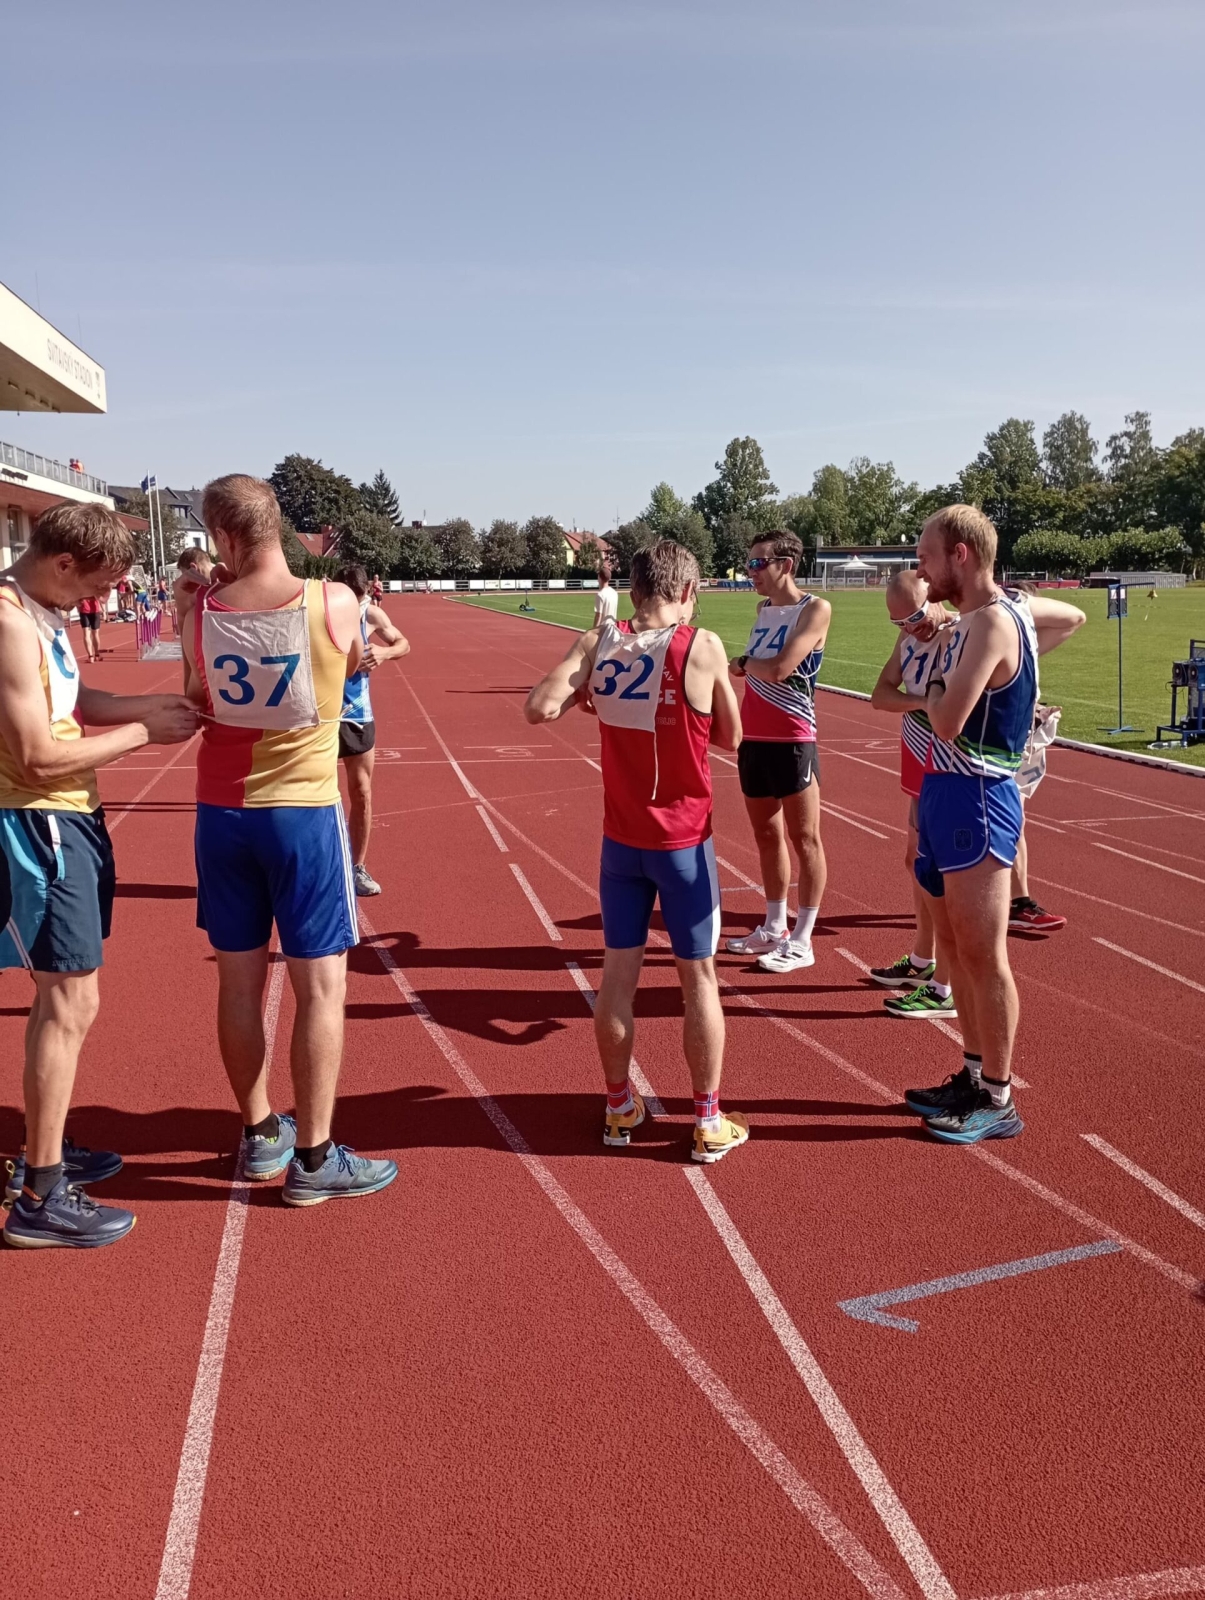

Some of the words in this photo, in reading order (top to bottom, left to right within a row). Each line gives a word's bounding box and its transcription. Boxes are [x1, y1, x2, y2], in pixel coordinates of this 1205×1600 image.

[749, 625, 788, 656] 74
[213, 653, 301, 707] 37
[593, 653, 655, 700] 32
